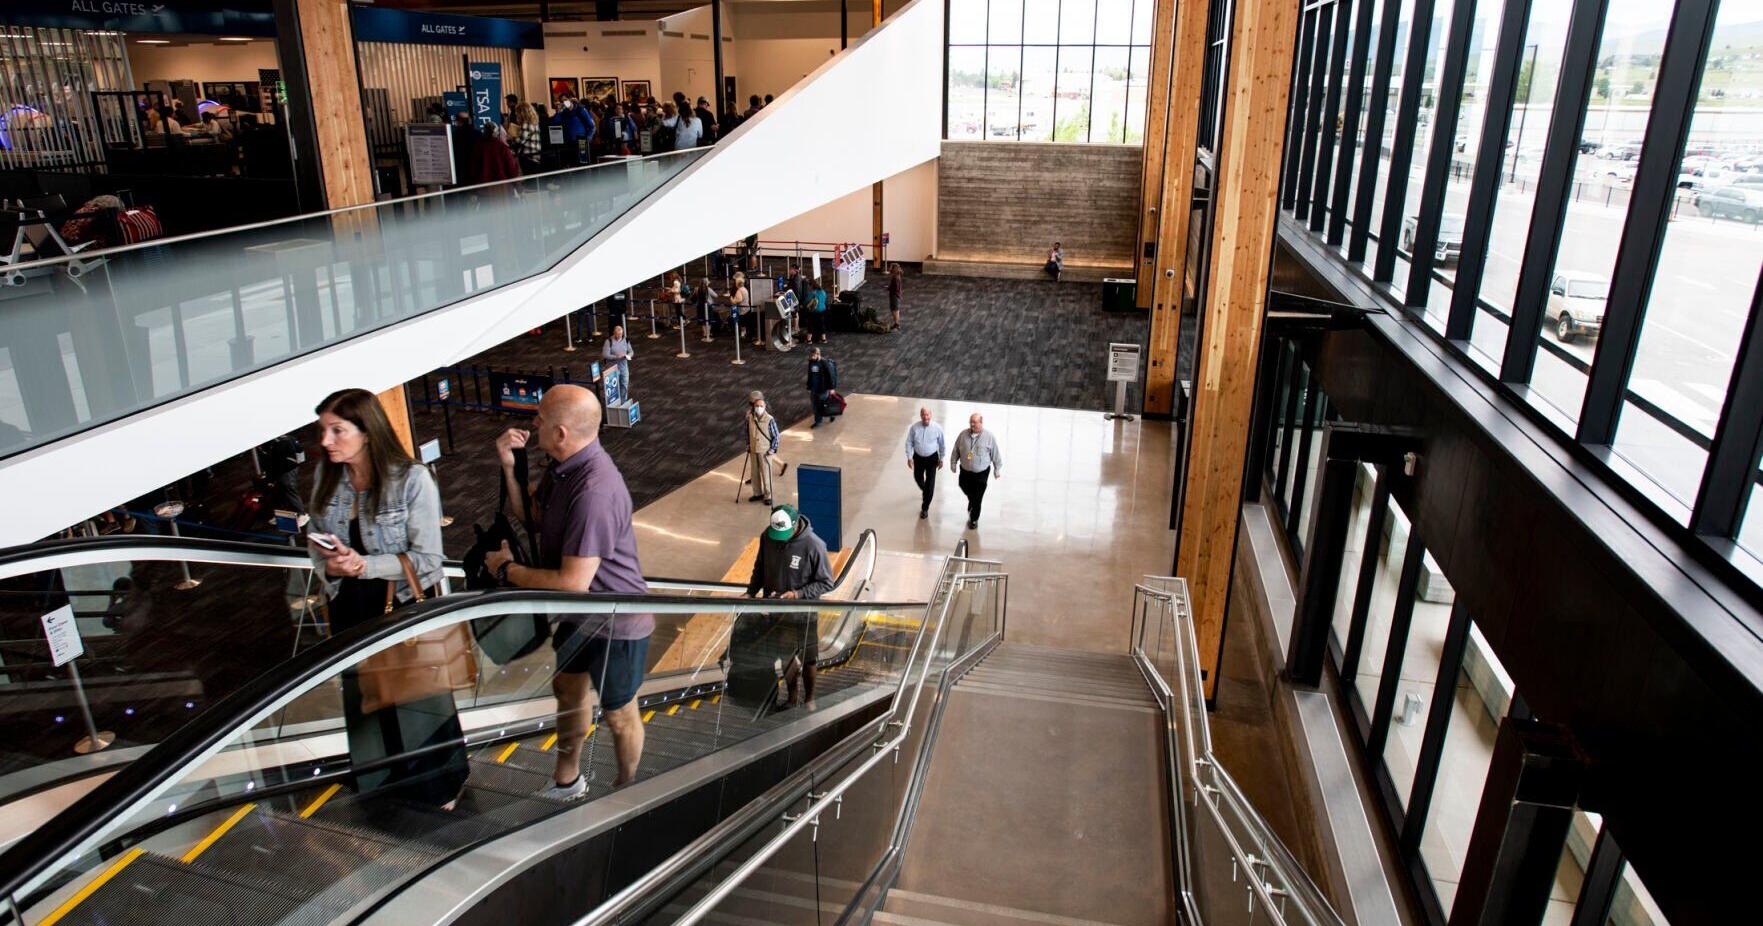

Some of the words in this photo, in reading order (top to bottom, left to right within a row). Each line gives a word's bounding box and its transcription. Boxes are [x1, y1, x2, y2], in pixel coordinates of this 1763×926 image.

[72, 0, 100, 13] ALL
[102, 1, 146, 16] GATES
[421, 24, 434, 33] ALL
[436, 25, 457, 35] GATES
[476, 88, 490, 113] TSA
